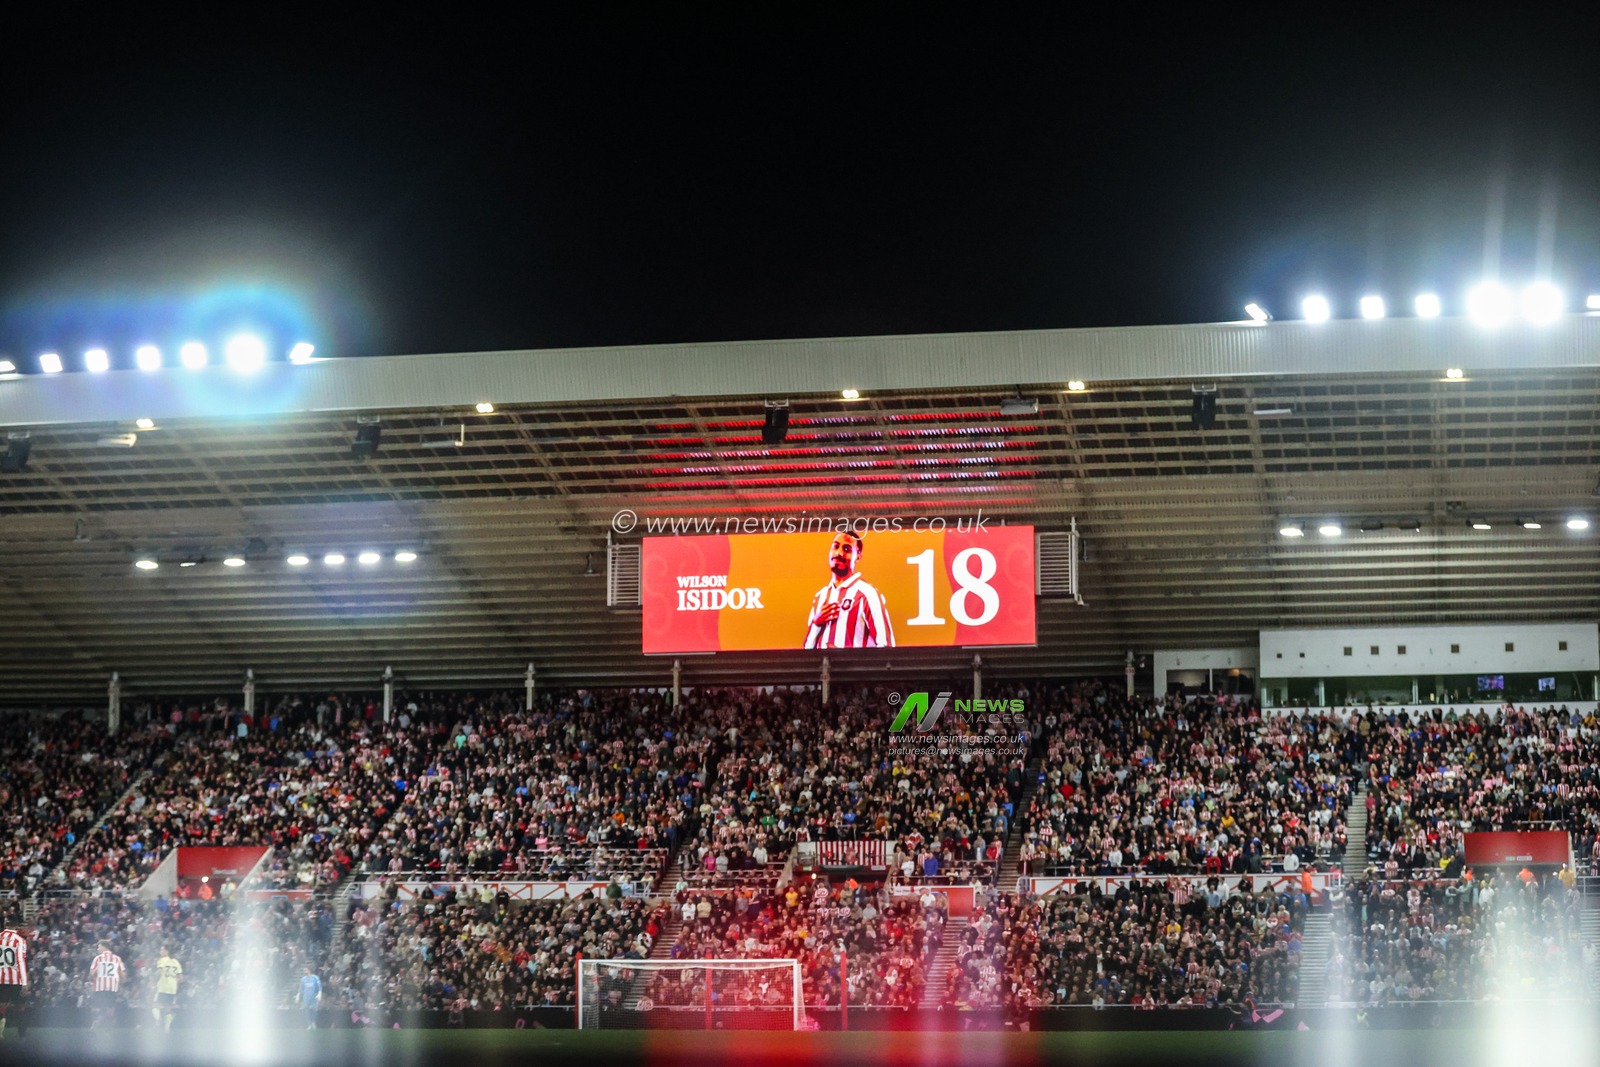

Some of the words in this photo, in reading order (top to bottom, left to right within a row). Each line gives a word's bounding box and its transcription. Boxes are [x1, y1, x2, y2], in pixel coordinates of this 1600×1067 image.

[676, 575, 727, 588] WILSON
[906, 547, 1000, 626] 18
[676, 588, 764, 611] ISIDOR
[101, 962, 115, 977] 12
